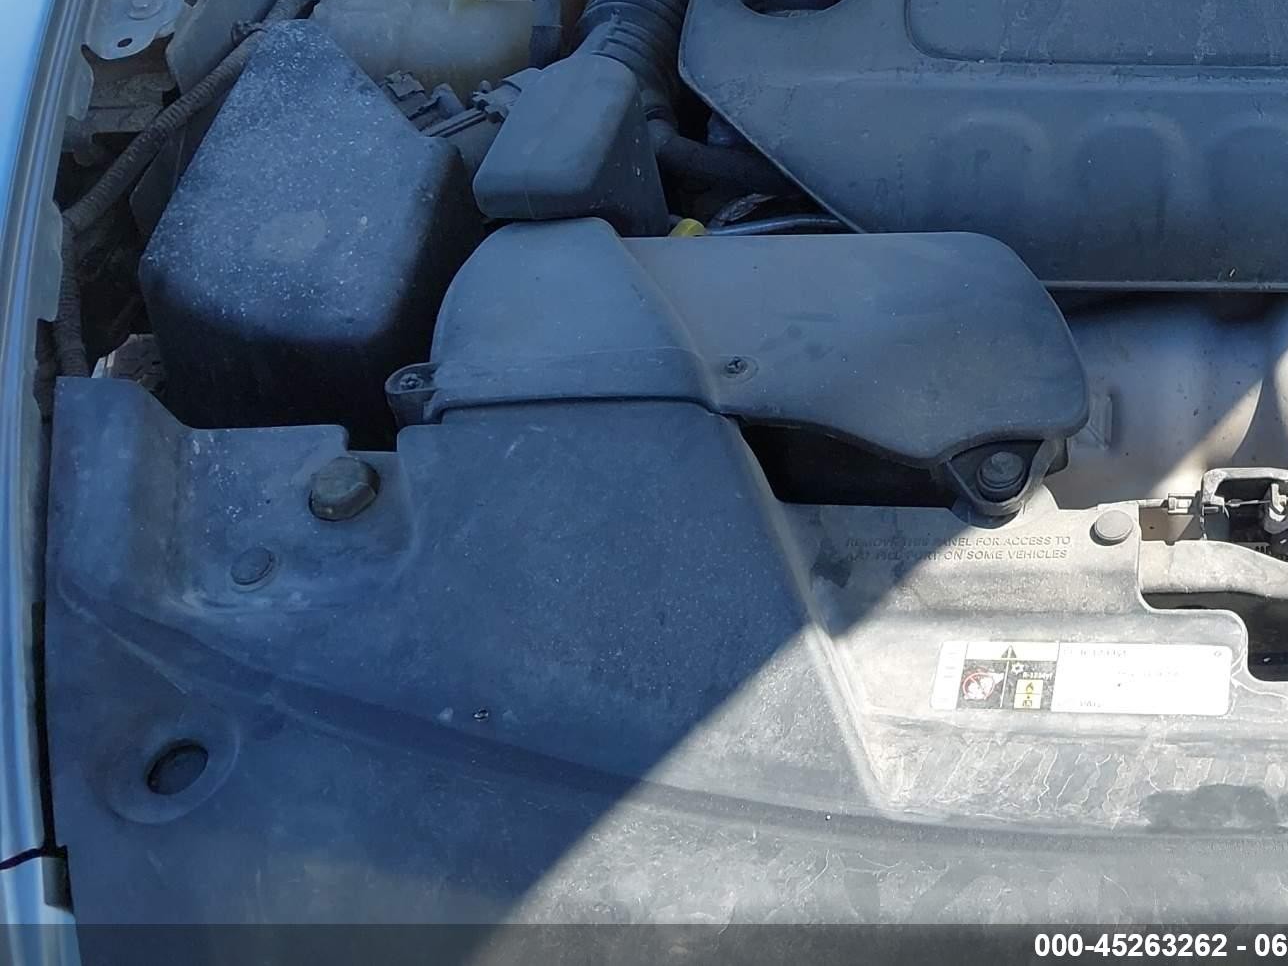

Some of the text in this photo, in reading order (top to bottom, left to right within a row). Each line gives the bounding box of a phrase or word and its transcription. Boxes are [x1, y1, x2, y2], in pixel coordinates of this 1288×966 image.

[976, 537, 999, 546] FOR
[1003, 536, 1051, 546] ACCESS
[1055, 536, 1071, 545] TO
[943, 550, 962, 560] ON
[966, 550, 1003, 560] SOME
[1007, 549, 1068, 560] VEHICLES
